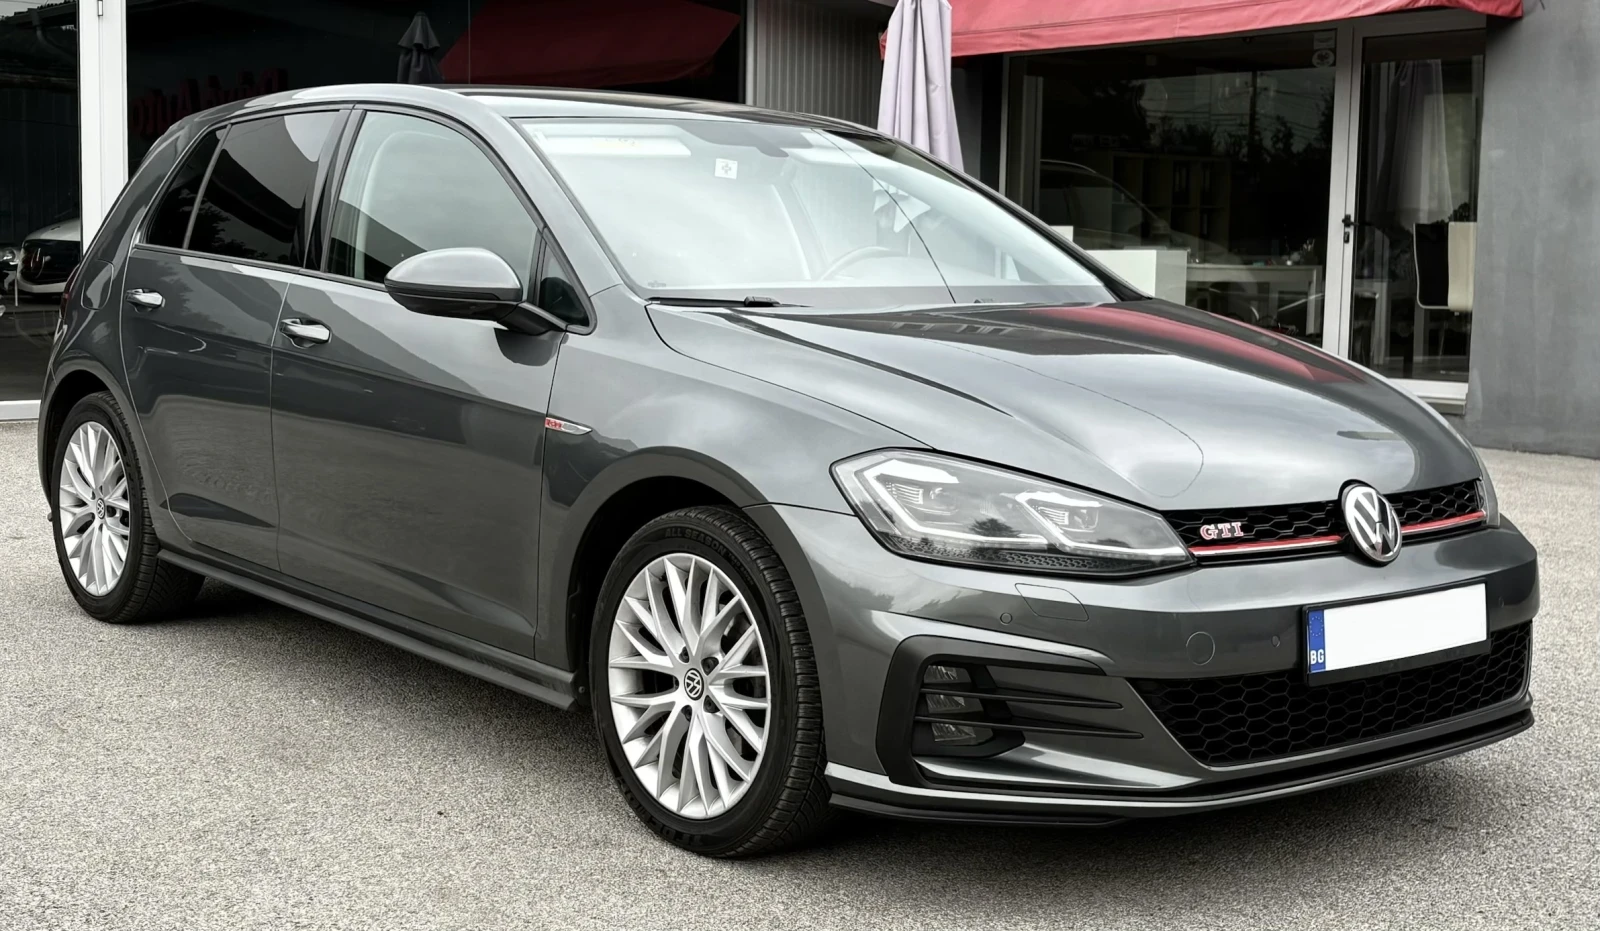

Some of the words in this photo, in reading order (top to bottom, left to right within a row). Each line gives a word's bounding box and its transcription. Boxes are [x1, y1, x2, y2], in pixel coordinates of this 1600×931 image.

[1199, 521, 1244, 541] GTI
[1342, 484, 1402, 561] VW
[664, 527, 682, 538] ALL
[684, 528, 727, 557] SEASON
[1310, 648, 1325, 665] BG
